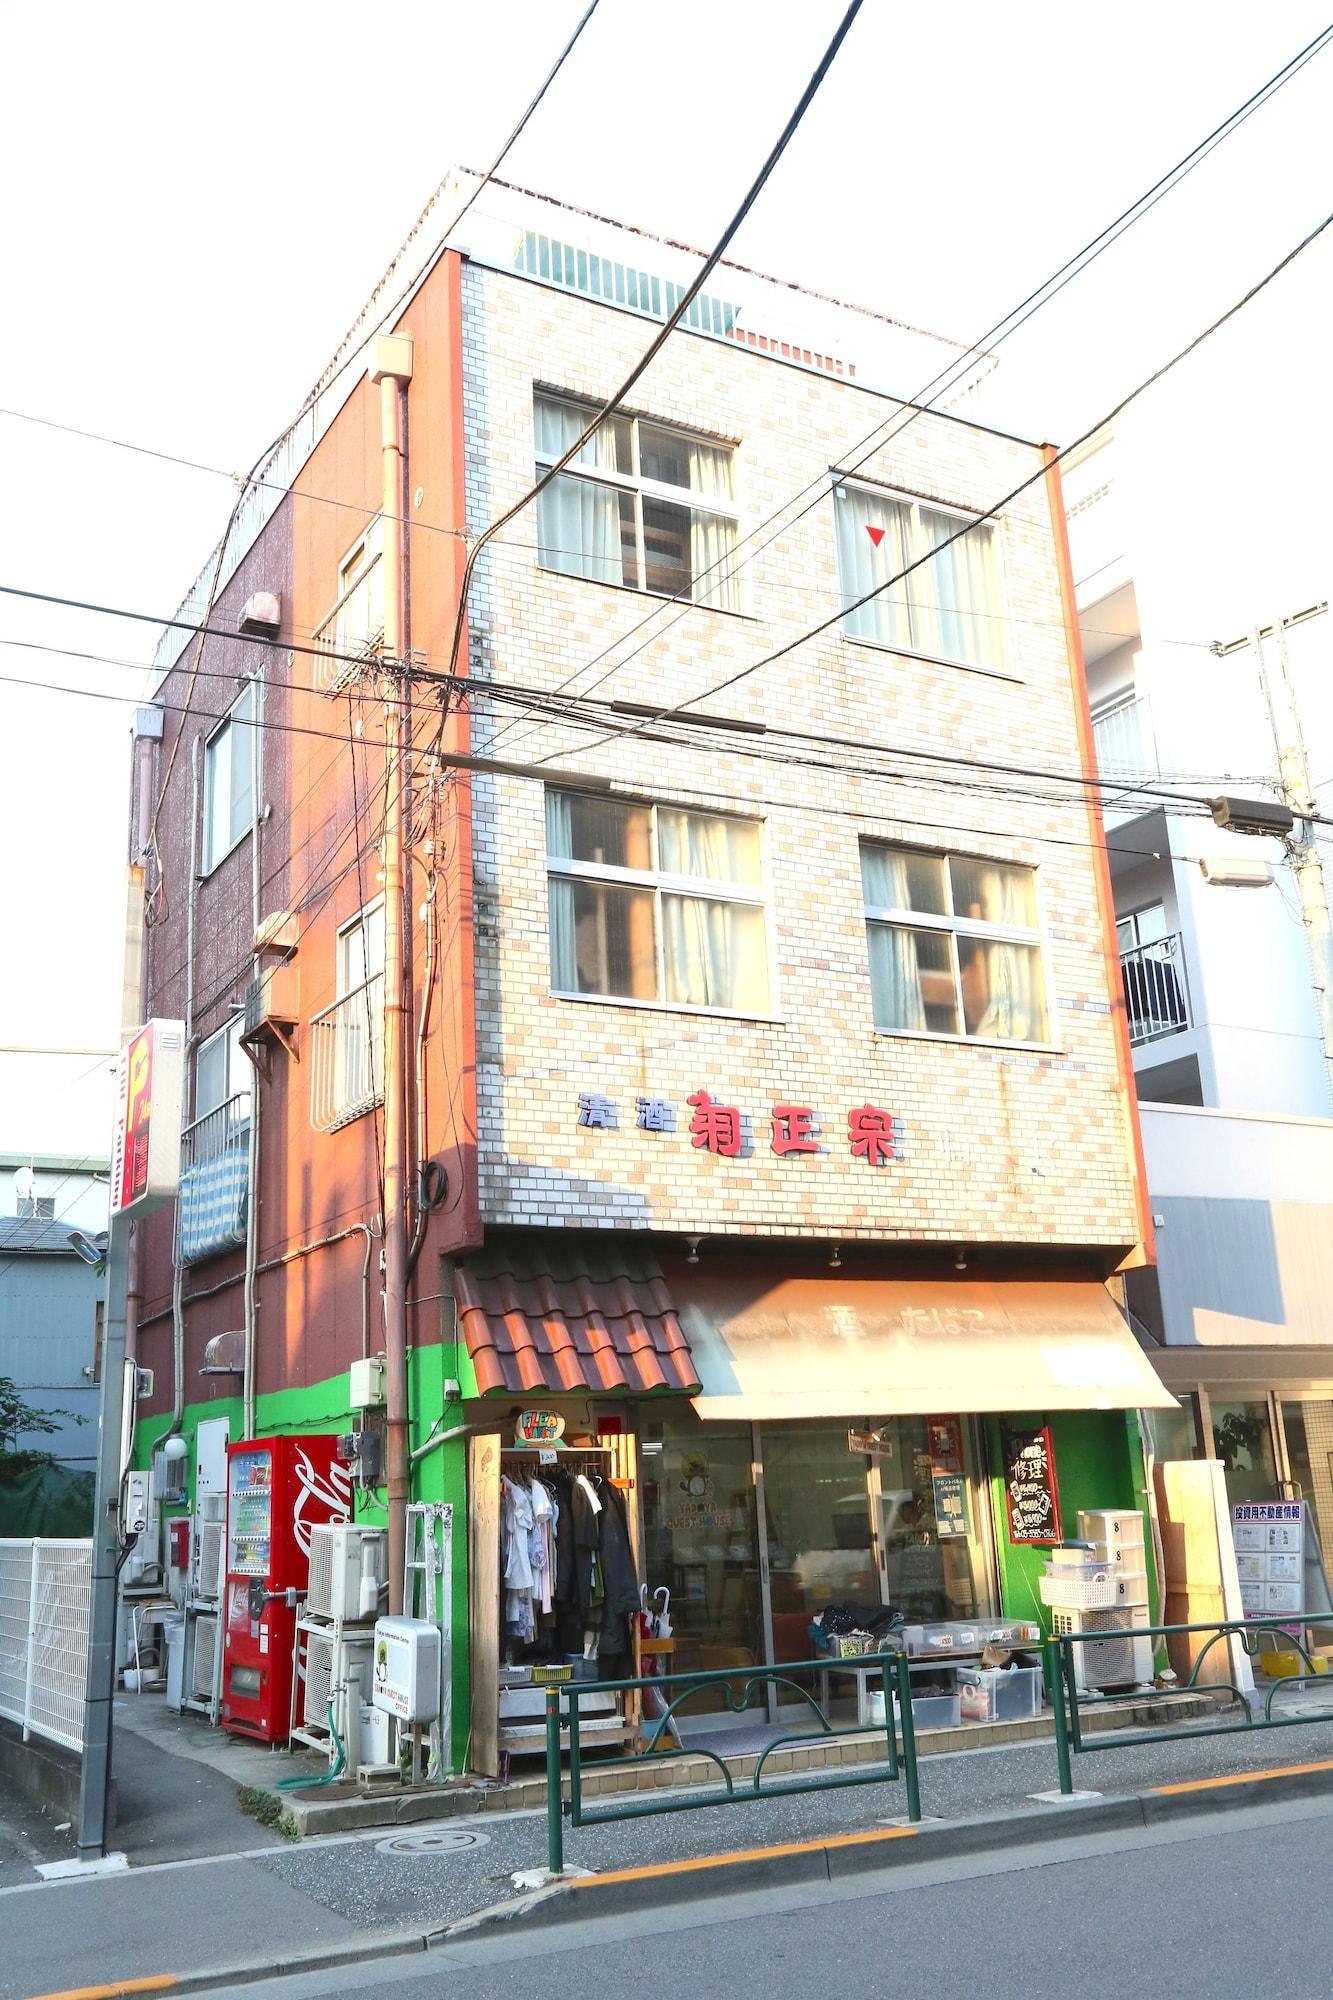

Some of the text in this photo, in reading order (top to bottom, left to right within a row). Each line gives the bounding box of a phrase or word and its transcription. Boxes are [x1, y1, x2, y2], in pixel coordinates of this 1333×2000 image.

[578, 1092, 662, 1130] 清酒
[824, 1304, 995, 1338] 酒 たばこ
[1011, 1459, 1043, 1480] 修理
